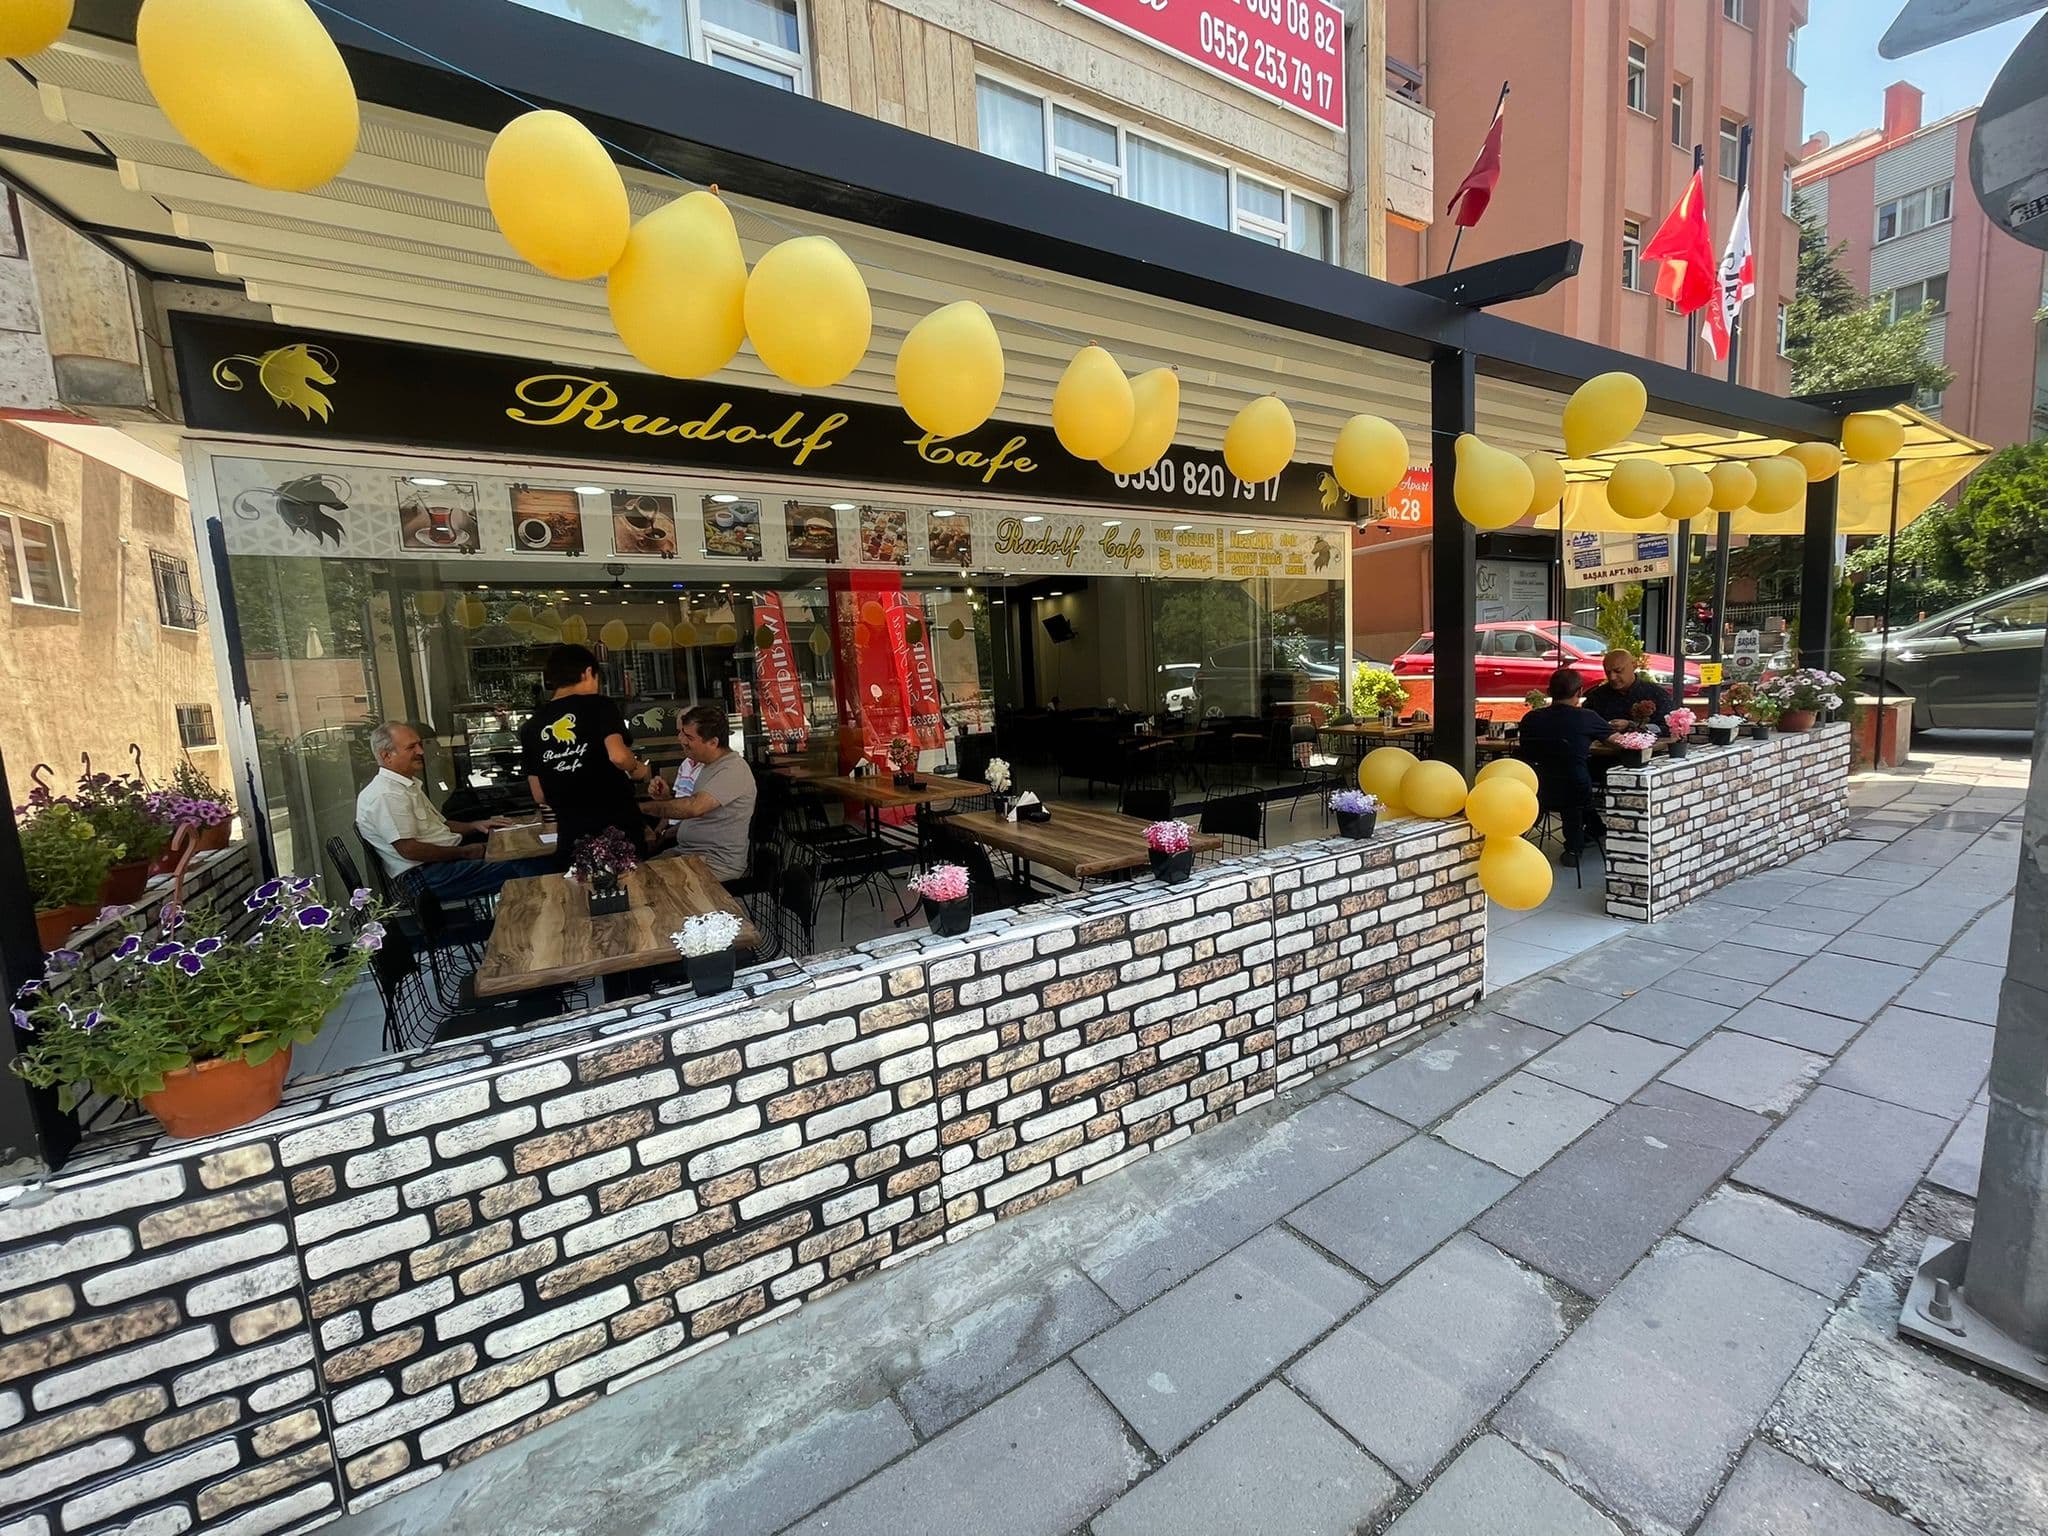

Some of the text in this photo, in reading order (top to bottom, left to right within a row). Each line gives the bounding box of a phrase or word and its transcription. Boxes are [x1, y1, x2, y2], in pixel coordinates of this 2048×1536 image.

[1287, 0, 1309, 40] 08
[1314, 11, 1335, 55] 82
[1200, 11, 1333, 110] 0552 253 79 17
[505, 373, 849, 466] Rudolf
[902, 432, 1038, 483] Cafe
[1183, 461, 1225, 498] 820
[1401, 498, 1421, 522] 28
[994, 517, 1145, 569] Rudolf Cafe
[1582, 570, 1608, 581] BAŞAR
[1627, 566, 1642, 575] NO:
[543, 742, 589, 763] Rudolf
